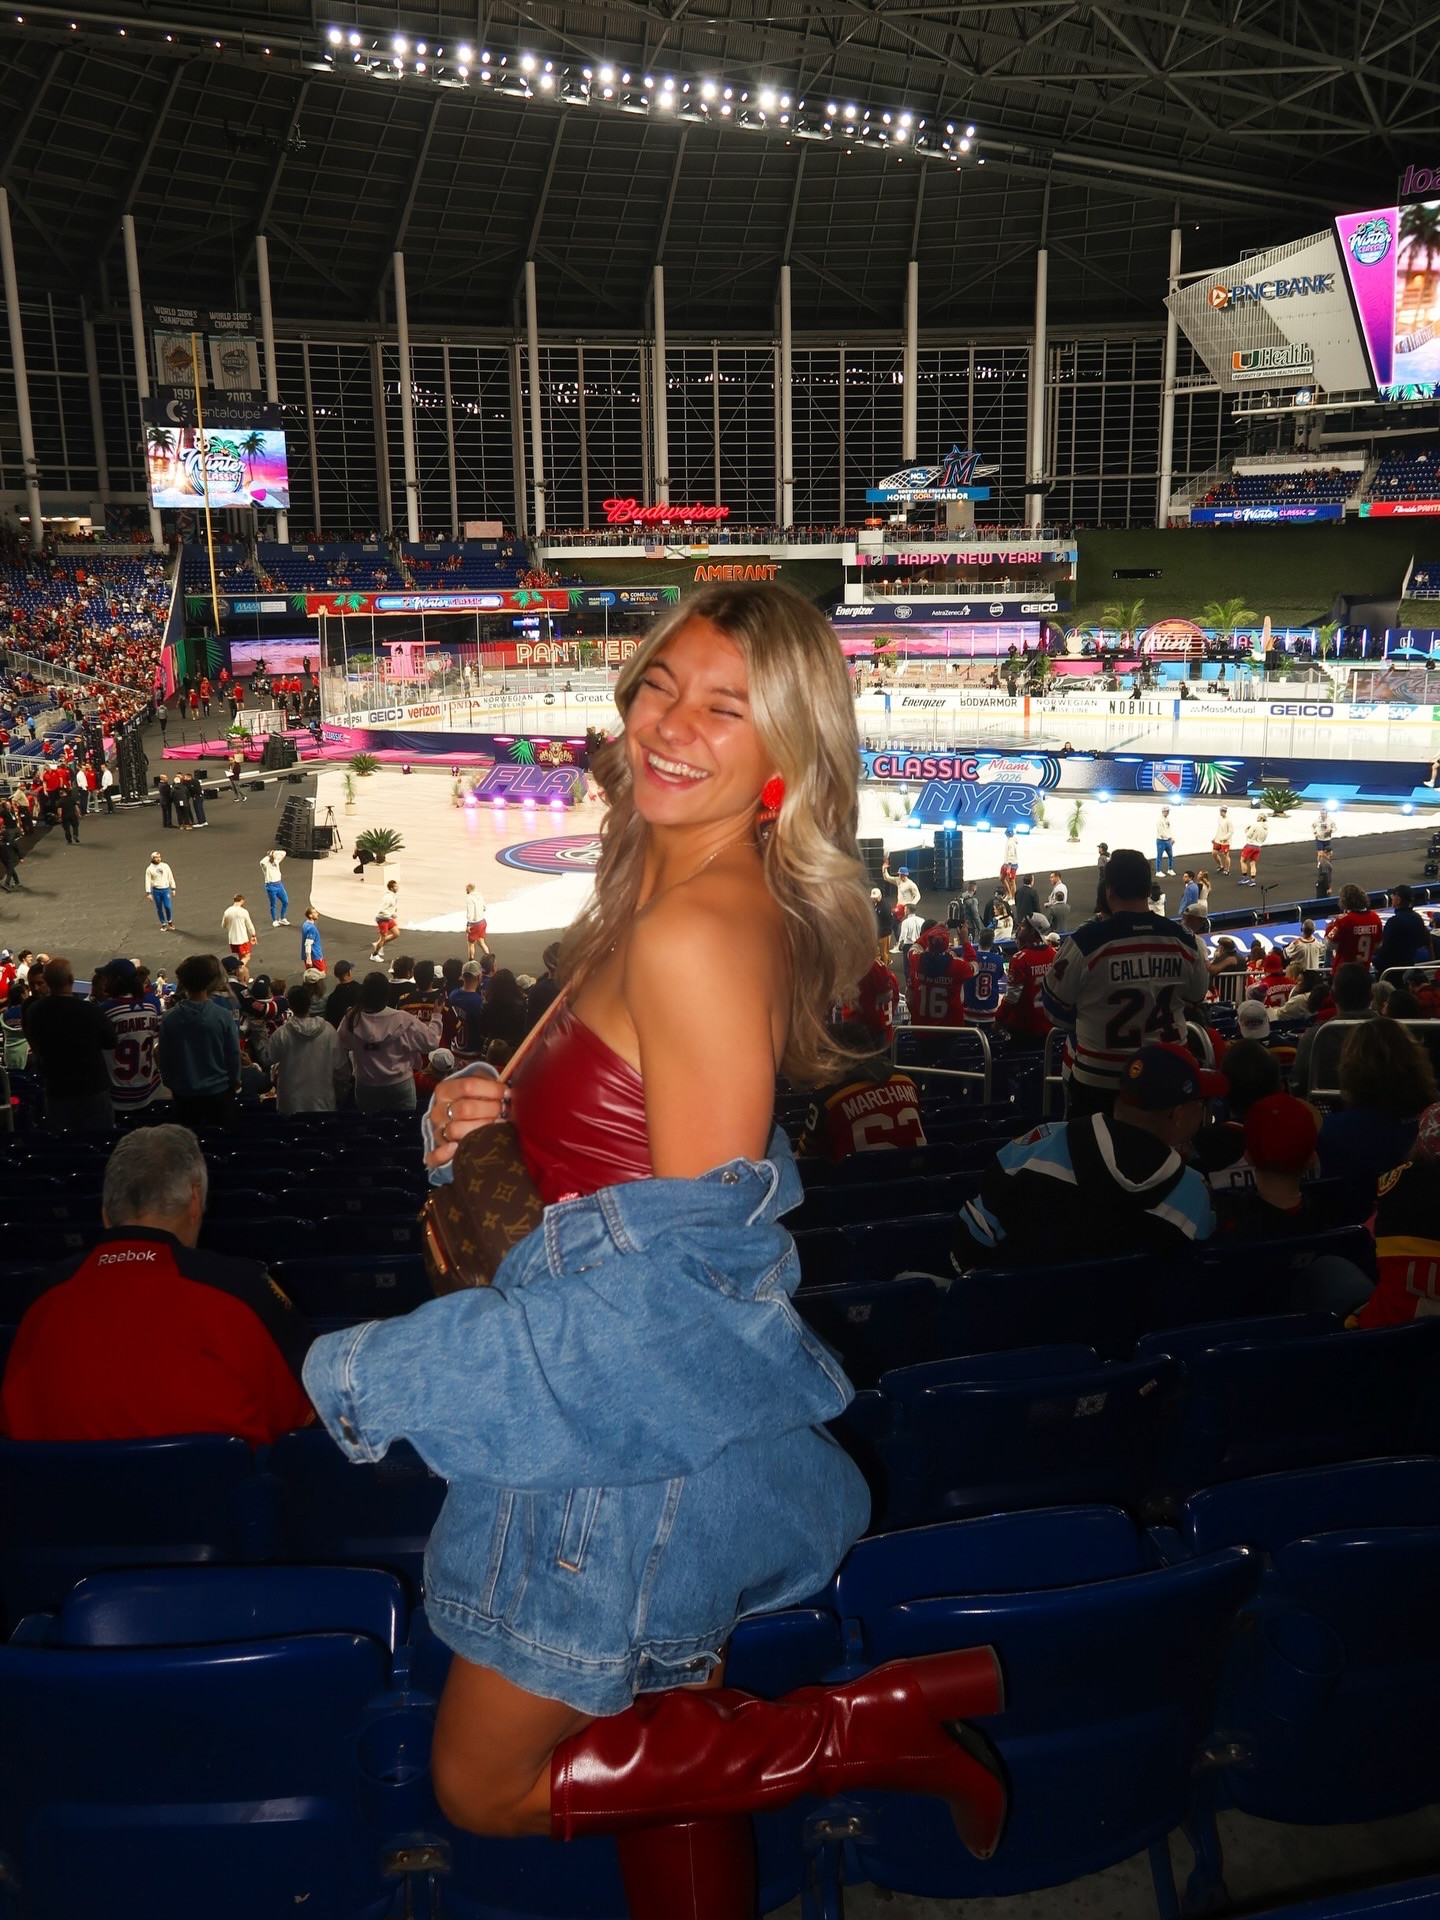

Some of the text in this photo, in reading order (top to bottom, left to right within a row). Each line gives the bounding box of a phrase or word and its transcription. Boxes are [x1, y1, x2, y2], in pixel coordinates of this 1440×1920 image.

[154, 306, 198, 319] WORLD SERIES
[209, 312, 252, 321] WORLD SERIES
[160, 316, 194, 327] CHAMPIONS
[214, 321, 249, 329] CHAMPIONS
[173, 388, 195, 401] 1997
[227, 392, 252, 402] 2003
[1297, 391, 1311, 401] 42
[180, 448, 248, 473] Winter
[934, 492, 968, 500] HARBOR
[603, 498, 730, 523] Budweiser
[1242, 508, 1279, 521] Winter
[1279, 509, 1307, 517] CLASSIC
[1392, 504, 1417, 514] Florida
[897, 551, 1043, 565] HAPPY NEW YEAR!
[694, 564, 778, 582] AMERANT
[413, 596, 450, 610] Winter
[1021, 603, 1059, 613] GEICO
[835, 605, 875, 618] Energizer
[516, 640, 643, 664] PANTER
[483, 693, 533, 704] NORWEGIAN
[575, 693, 604, 703] Great
[901, 696, 947, 710] Energizer
[960, 697, 1018, 708] BODYARMOR
[1036, 698, 1098, 706] NORWEGIAN
[407, 704, 441, 719] verizon
[1109, 700, 1162, 715] NOBULL
[1201, 705, 1256, 714] MassMutual
[1270, 704, 1334, 718] GEICO
[1350, 705, 1373, 717] SAP
[1388, 706, 1412, 718] SAP
[369, 709, 404, 723] GEICO
[874, 755, 980, 782] CLASSIC
[988, 759, 1031, 772] Miami
[1167, 764, 1181, 772] YORK
[481, 765, 580, 795] FLA
[994, 772, 1022, 783] 2026
[917, 782, 1037, 816] NYR
[1353, 924, 1378, 935] BENNETT
[1356, 936, 1373, 964] 9
[1030, 962, 1053, 977] TROCHE
[1110, 957, 1184, 982] CALLIHAN
[974, 972, 993, 1001] 8
[918, 983, 949, 1019] 16
[1105, 984, 1183, 1049] 24
[113, 1037, 154, 1081] 93
[841, 1085, 919, 1121] MARCHAND
[98, 1249, 157, 1266] Reebok
